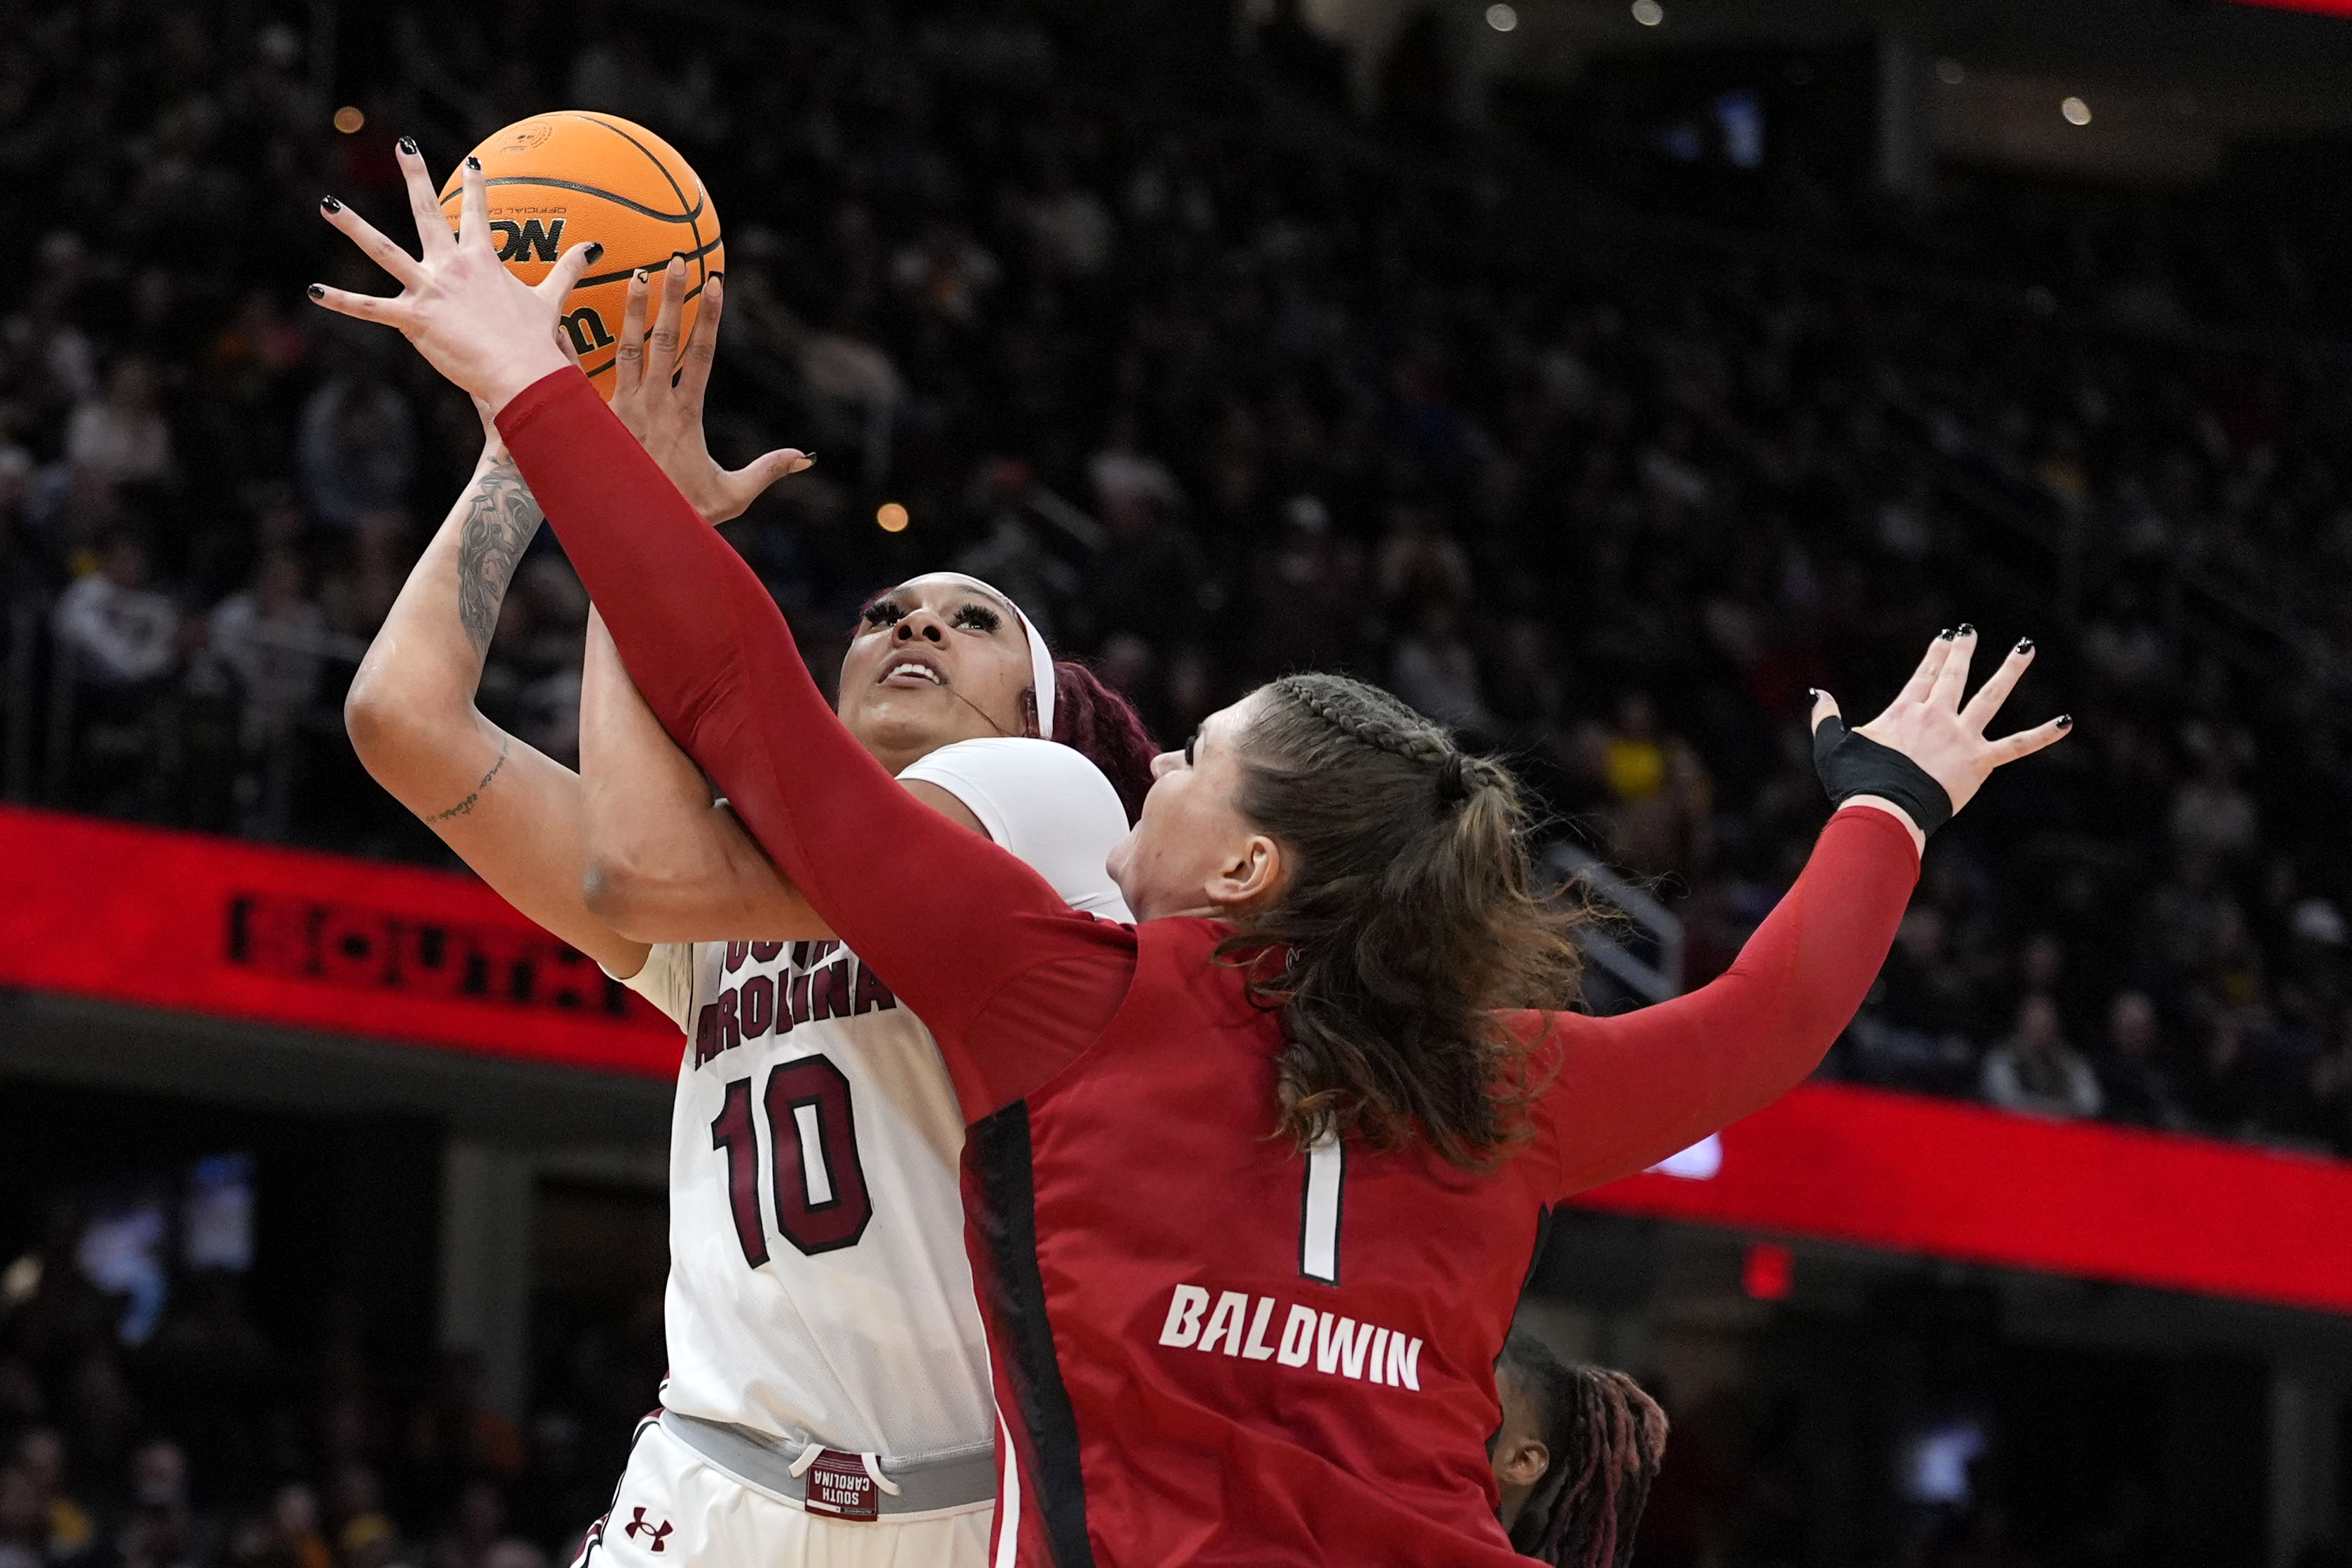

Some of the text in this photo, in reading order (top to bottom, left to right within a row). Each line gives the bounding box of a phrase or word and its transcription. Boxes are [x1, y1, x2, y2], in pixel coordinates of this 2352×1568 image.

[694, 958, 897, 1072] AROLINA
[711, 1054, 873, 1270] 10
[1158, 1283, 1424, 1392] BALDWIN
[814, 1471, 870, 1492] CAROLINA
[822, 1488, 860, 1506] SOUTH
